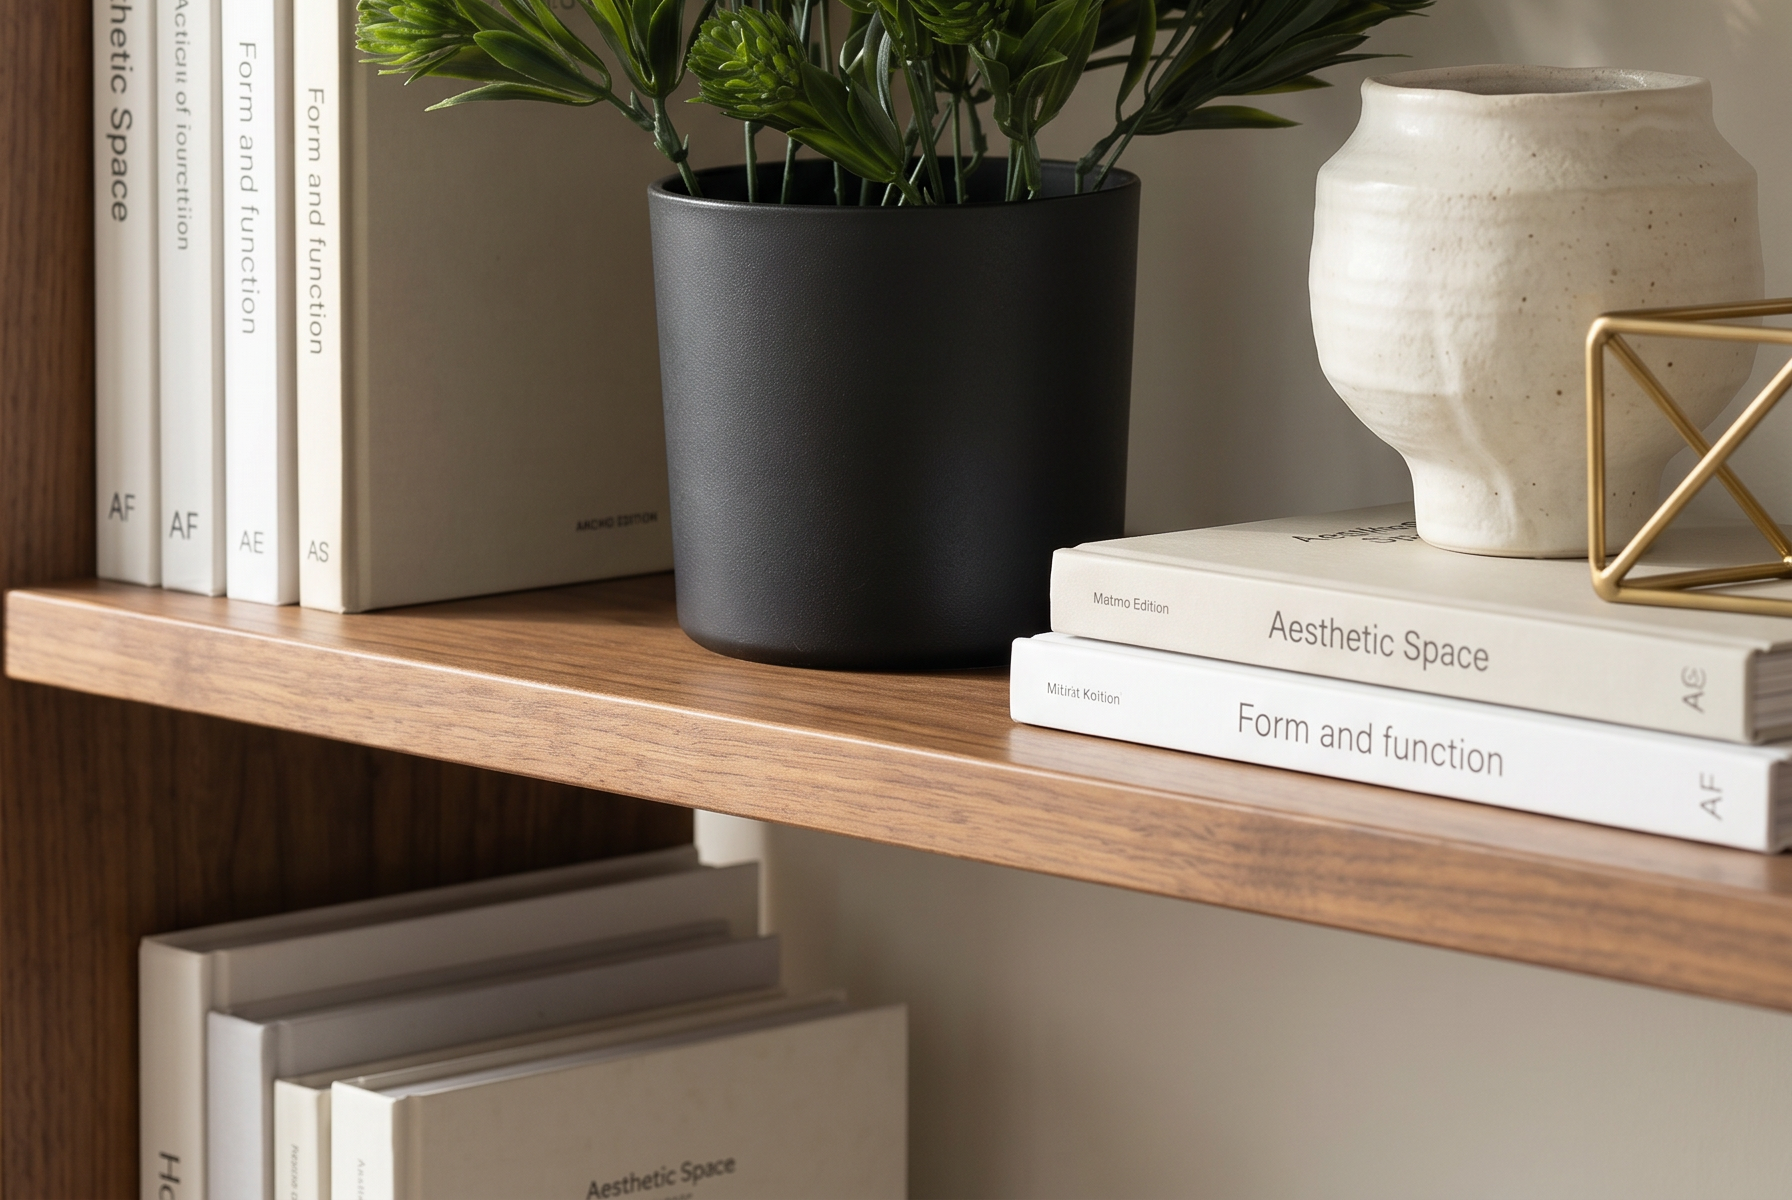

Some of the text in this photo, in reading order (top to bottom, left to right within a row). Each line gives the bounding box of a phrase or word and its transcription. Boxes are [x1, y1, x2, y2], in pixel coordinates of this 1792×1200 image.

[106, 108, 133, 223] Space
[239, 41, 259, 334] Form and function
[307, 88, 327, 355] Form and function
[109, 492, 136, 521] AF
[170, 511, 199, 540] AF
[240, 530, 264, 555] AE
[308, 540, 330, 564] AS
[1094, 592, 1170, 615] Matmo Edition
[1269, 611, 1490, 673] Aesthetic Space
[1084, 689, 1120, 706] Koition
[1239, 702, 1503, 777] Form and function
[1700, 772, 1723, 821] AF
[585, 1157, 737, 1200] Aesthetic Space
